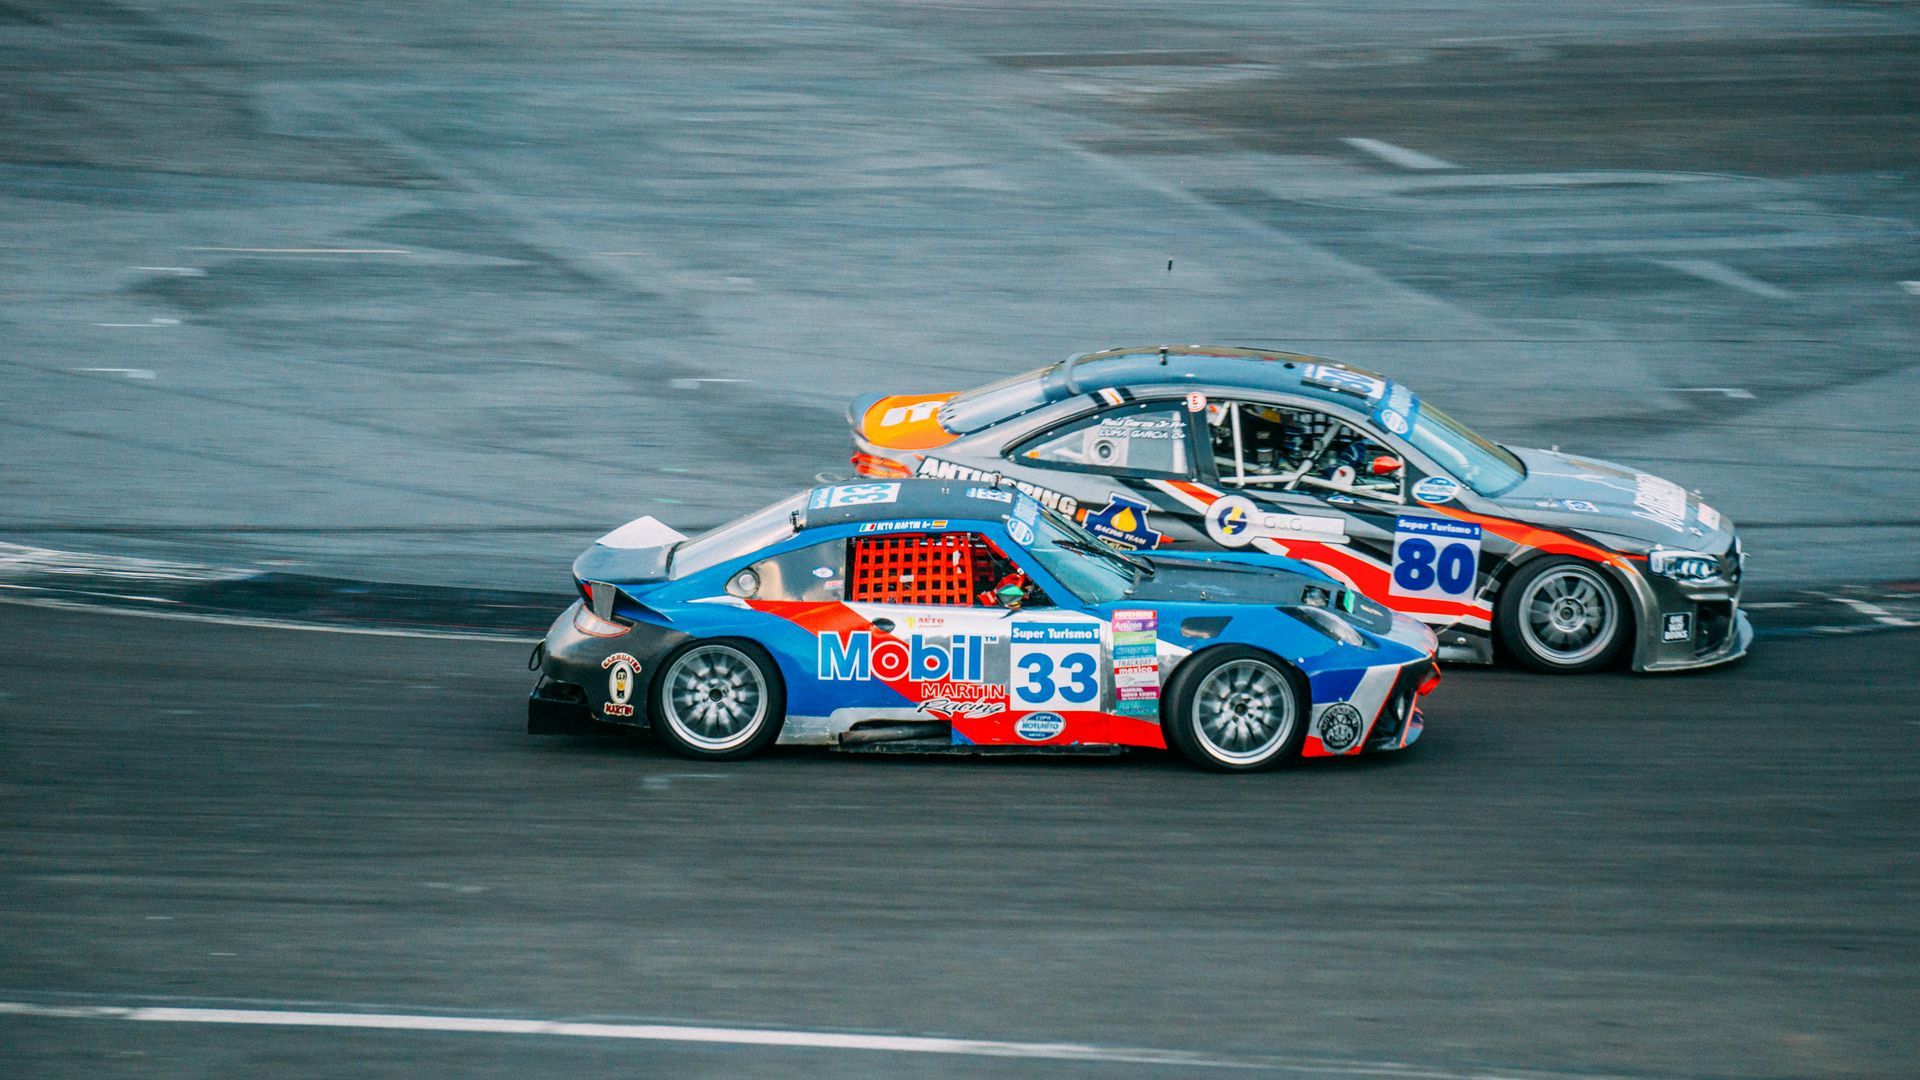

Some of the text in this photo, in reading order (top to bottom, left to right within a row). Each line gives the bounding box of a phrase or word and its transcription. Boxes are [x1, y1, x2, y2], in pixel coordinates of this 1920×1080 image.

[1398, 519, 1480, 535] Super Turismo 1
[1124, 533, 1147, 545] TEAM
[1394, 538, 1475, 595] 80
[1012, 628, 1044, 640] Super
[817, 630, 984, 682] Mobil
[1016, 652, 1099, 704] 33
[921, 682, 1006, 699] MARTIN
[604, 702, 634, 716] MARTIN
[916, 698, 1006, 718] Racing
